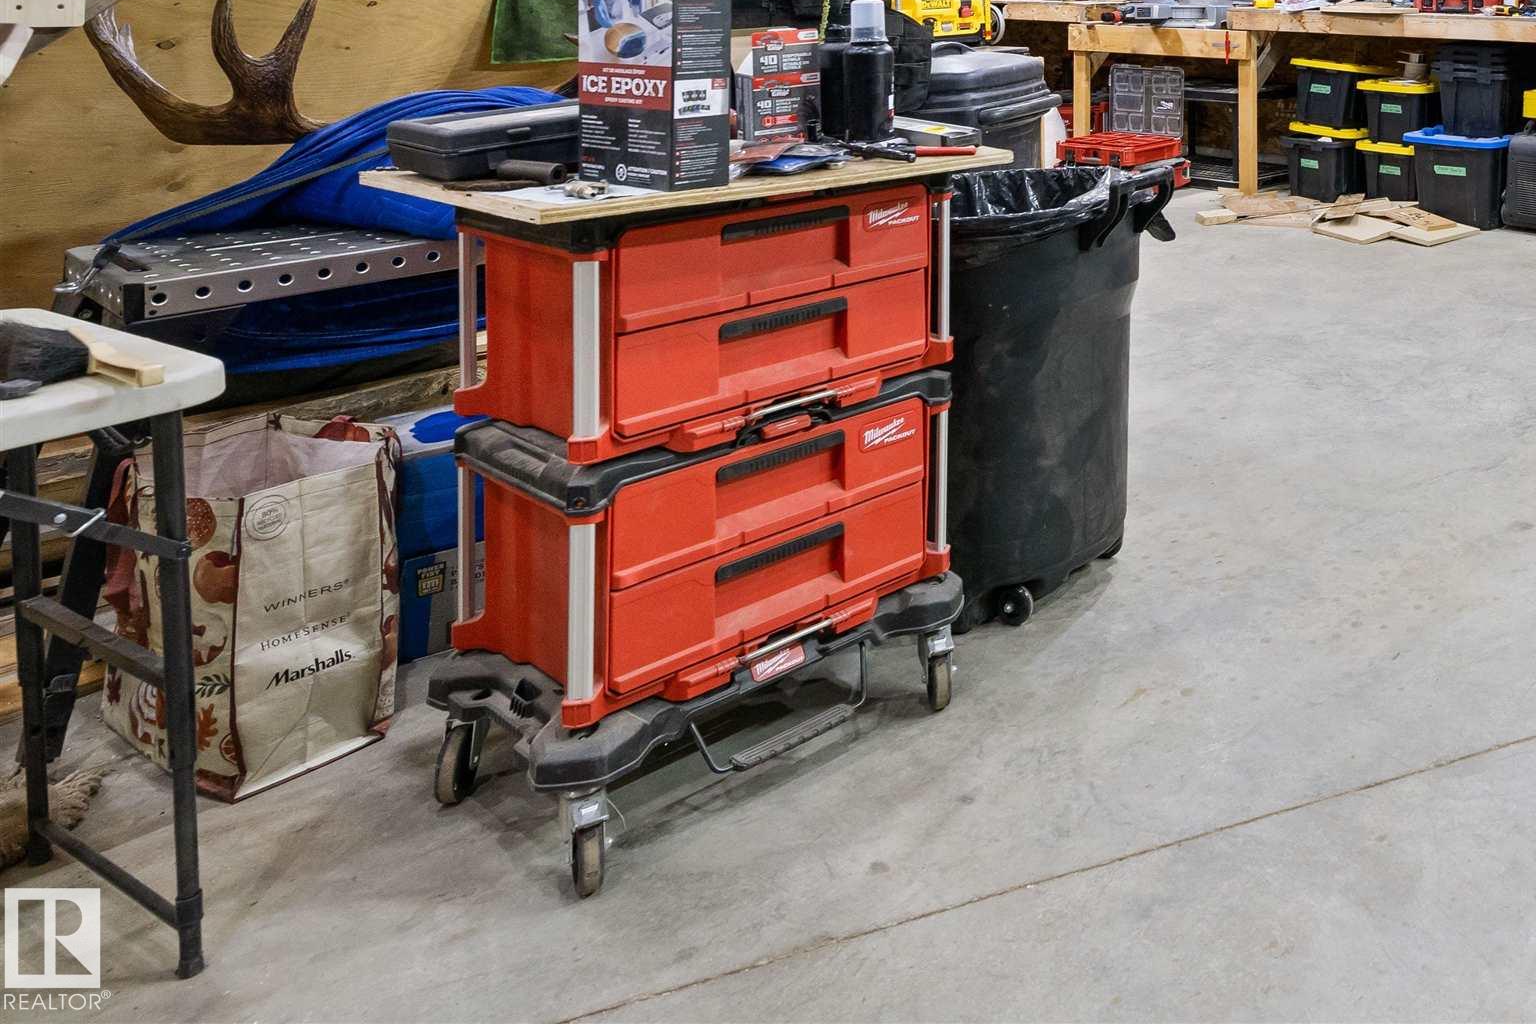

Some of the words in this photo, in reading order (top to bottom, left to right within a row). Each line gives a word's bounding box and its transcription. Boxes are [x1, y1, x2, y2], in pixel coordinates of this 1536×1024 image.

[581, 75, 608, 93] ICE
[610, 76, 667, 97] EPOXY
[264, 580, 344, 613] WINNERS
[265, 649, 352, 691] Marshalls
